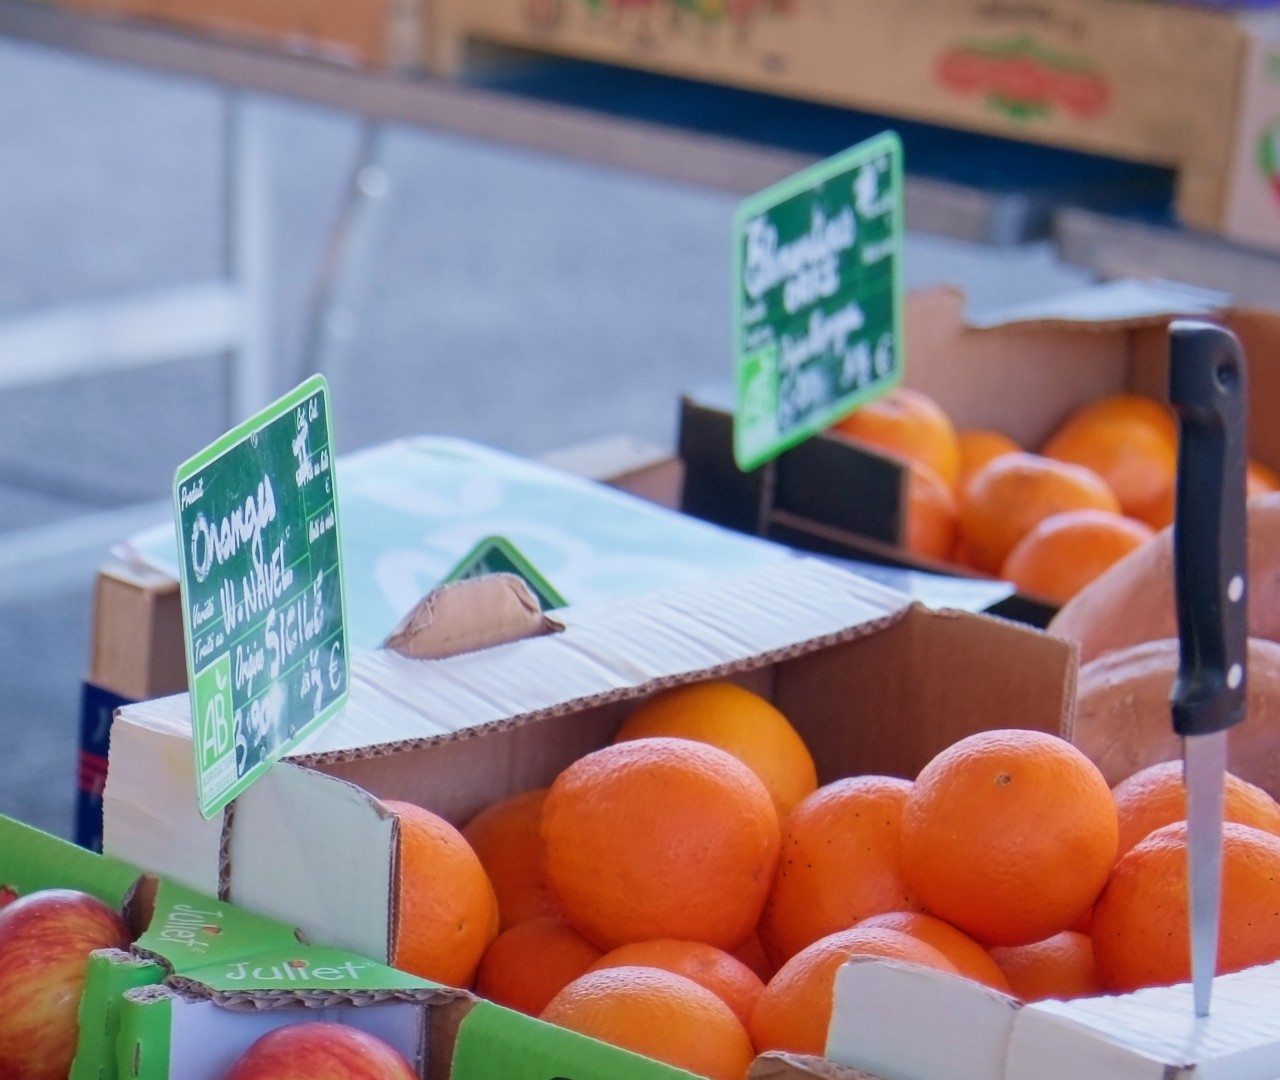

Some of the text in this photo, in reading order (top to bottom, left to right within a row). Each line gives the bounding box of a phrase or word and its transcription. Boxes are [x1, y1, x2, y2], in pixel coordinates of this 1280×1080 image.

[180, 477, 204, 512] Produit
[191, 473, 276, 584] Oranges
[192, 596, 215, 630] Variété
[236, 640, 264, 698] Origine
[328, 641, 342, 691] €
[203, 692, 228, 767] AB
